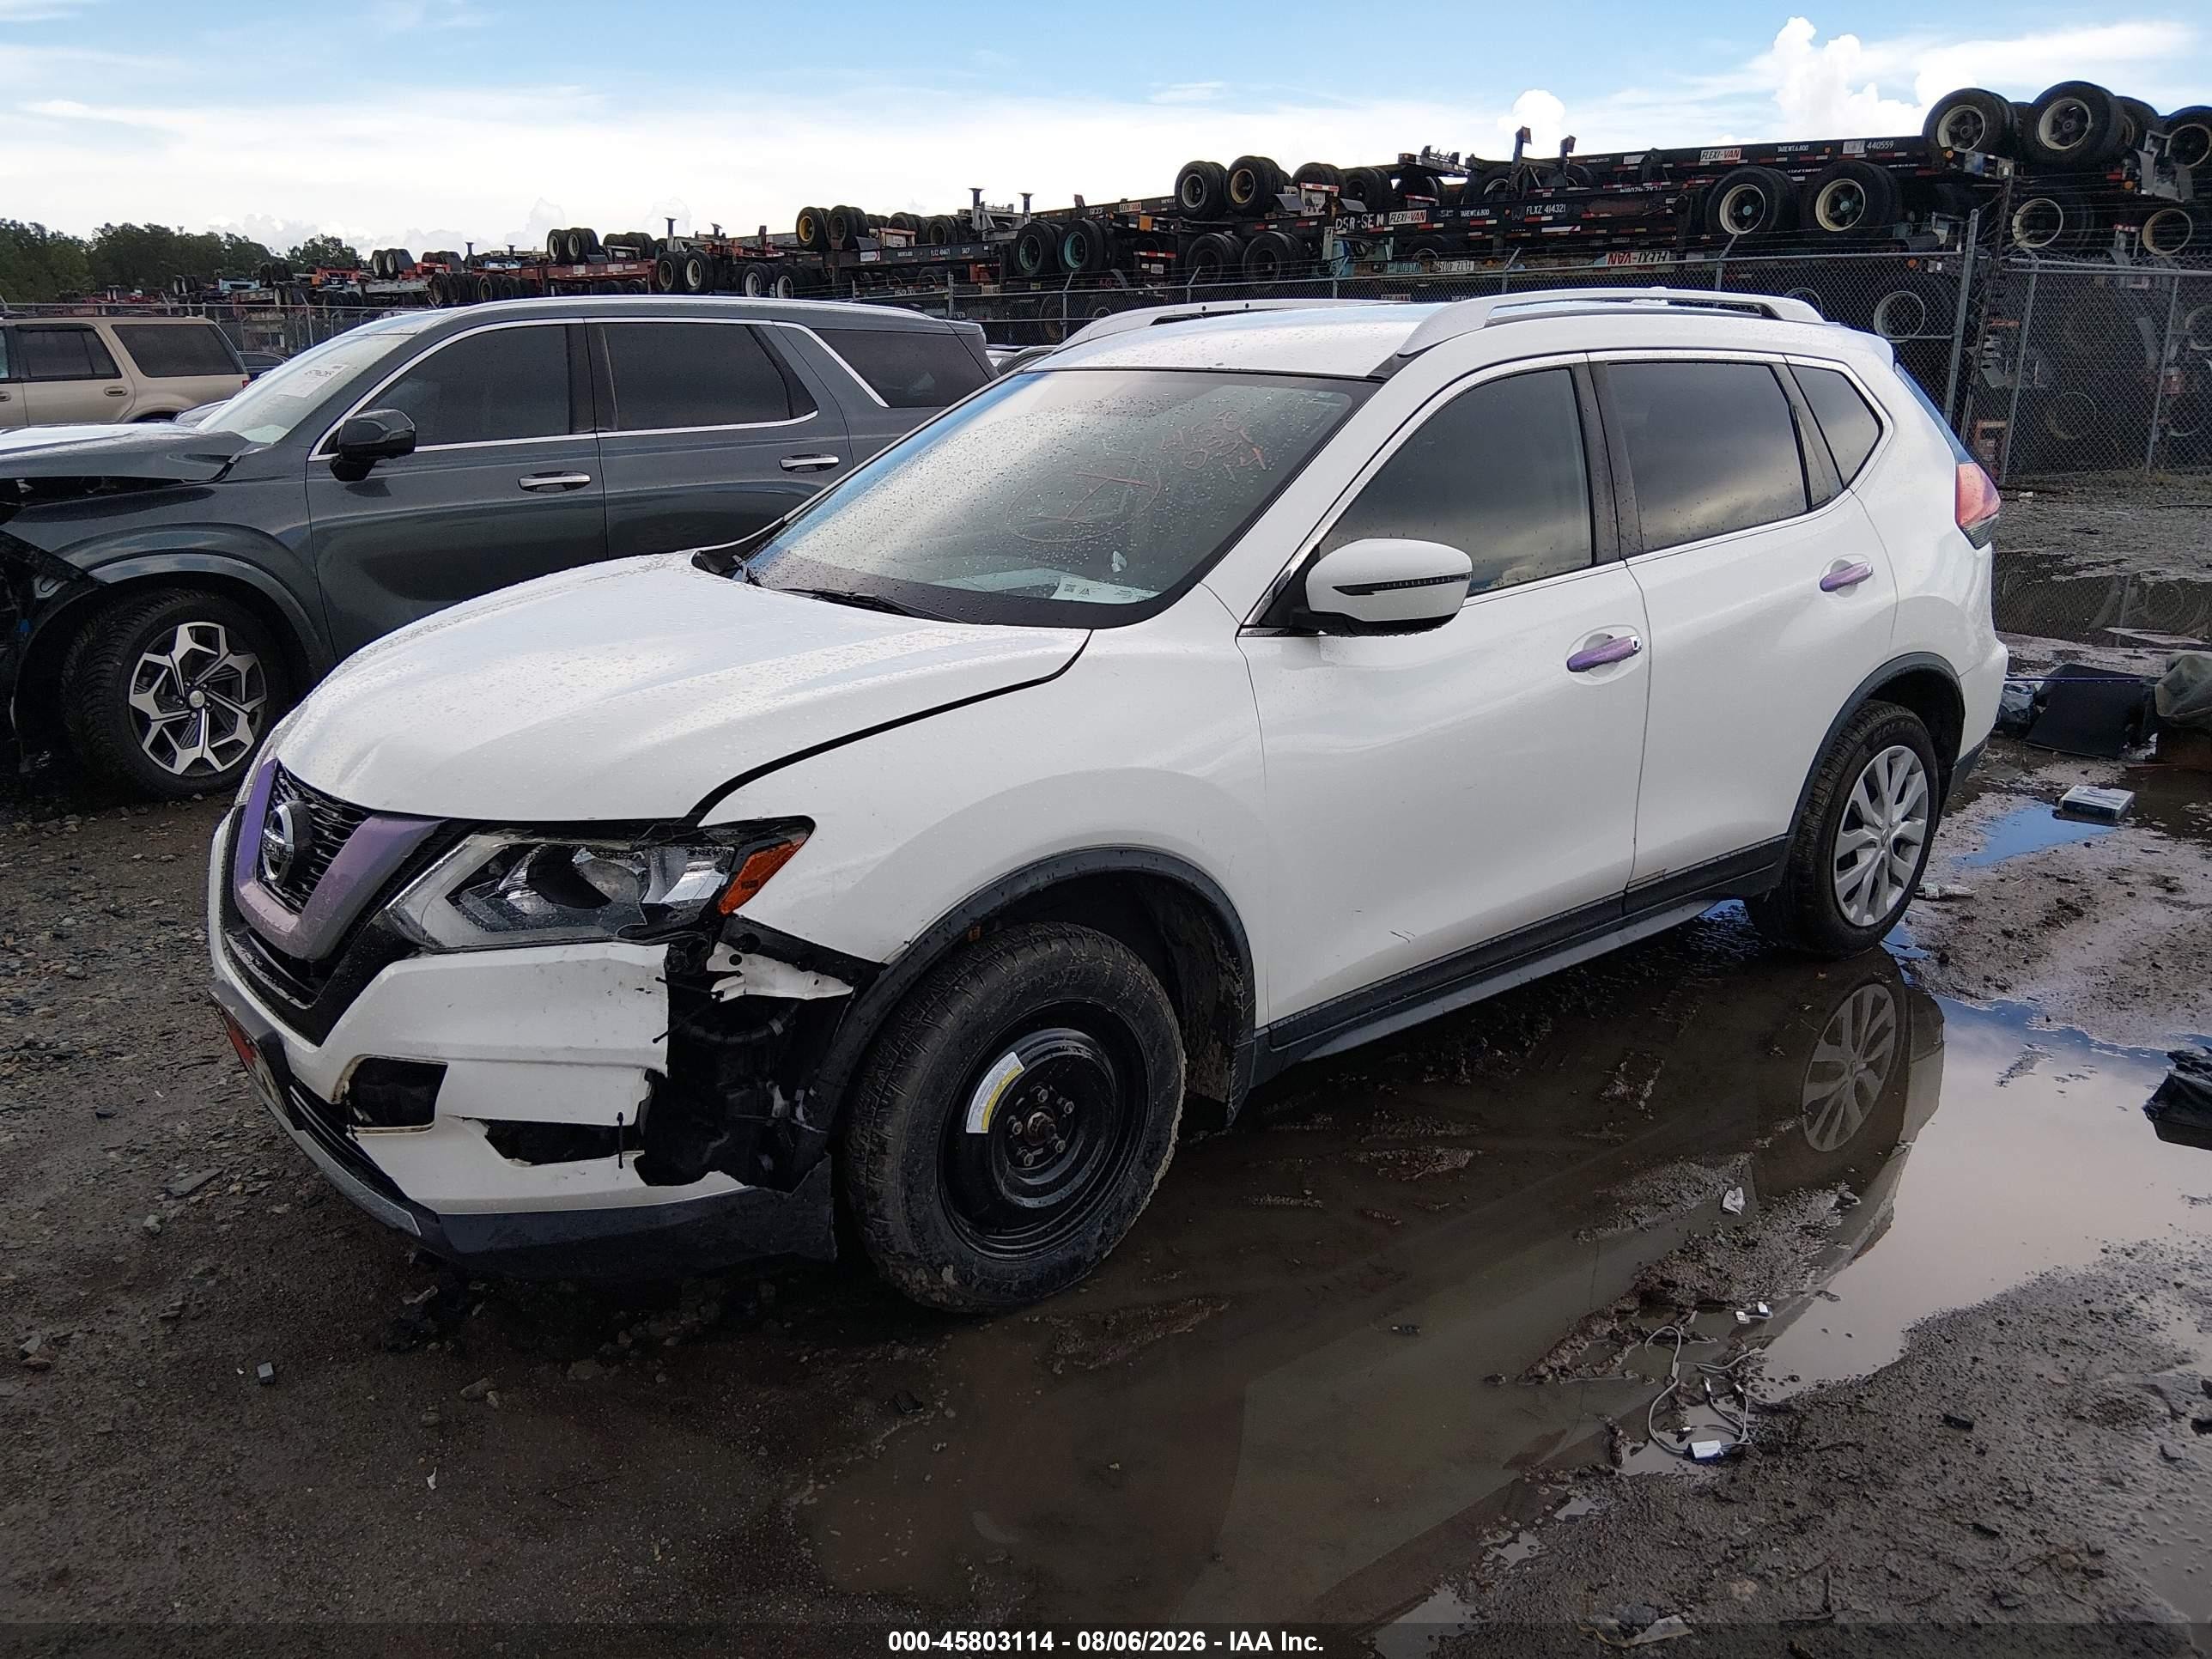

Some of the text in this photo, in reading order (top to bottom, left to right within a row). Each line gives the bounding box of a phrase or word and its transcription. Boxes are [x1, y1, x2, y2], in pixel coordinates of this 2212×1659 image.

[1867, 140, 1894, 149] 440559
[1700, 149, 1741, 160] FLEXI-VAN
[1526, 204, 1566, 215] FLXZ 414321
[1390, 211, 1425, 223] FLEXI-VAN
[1607, 252, 1668, 264] FLEXI-VAN
